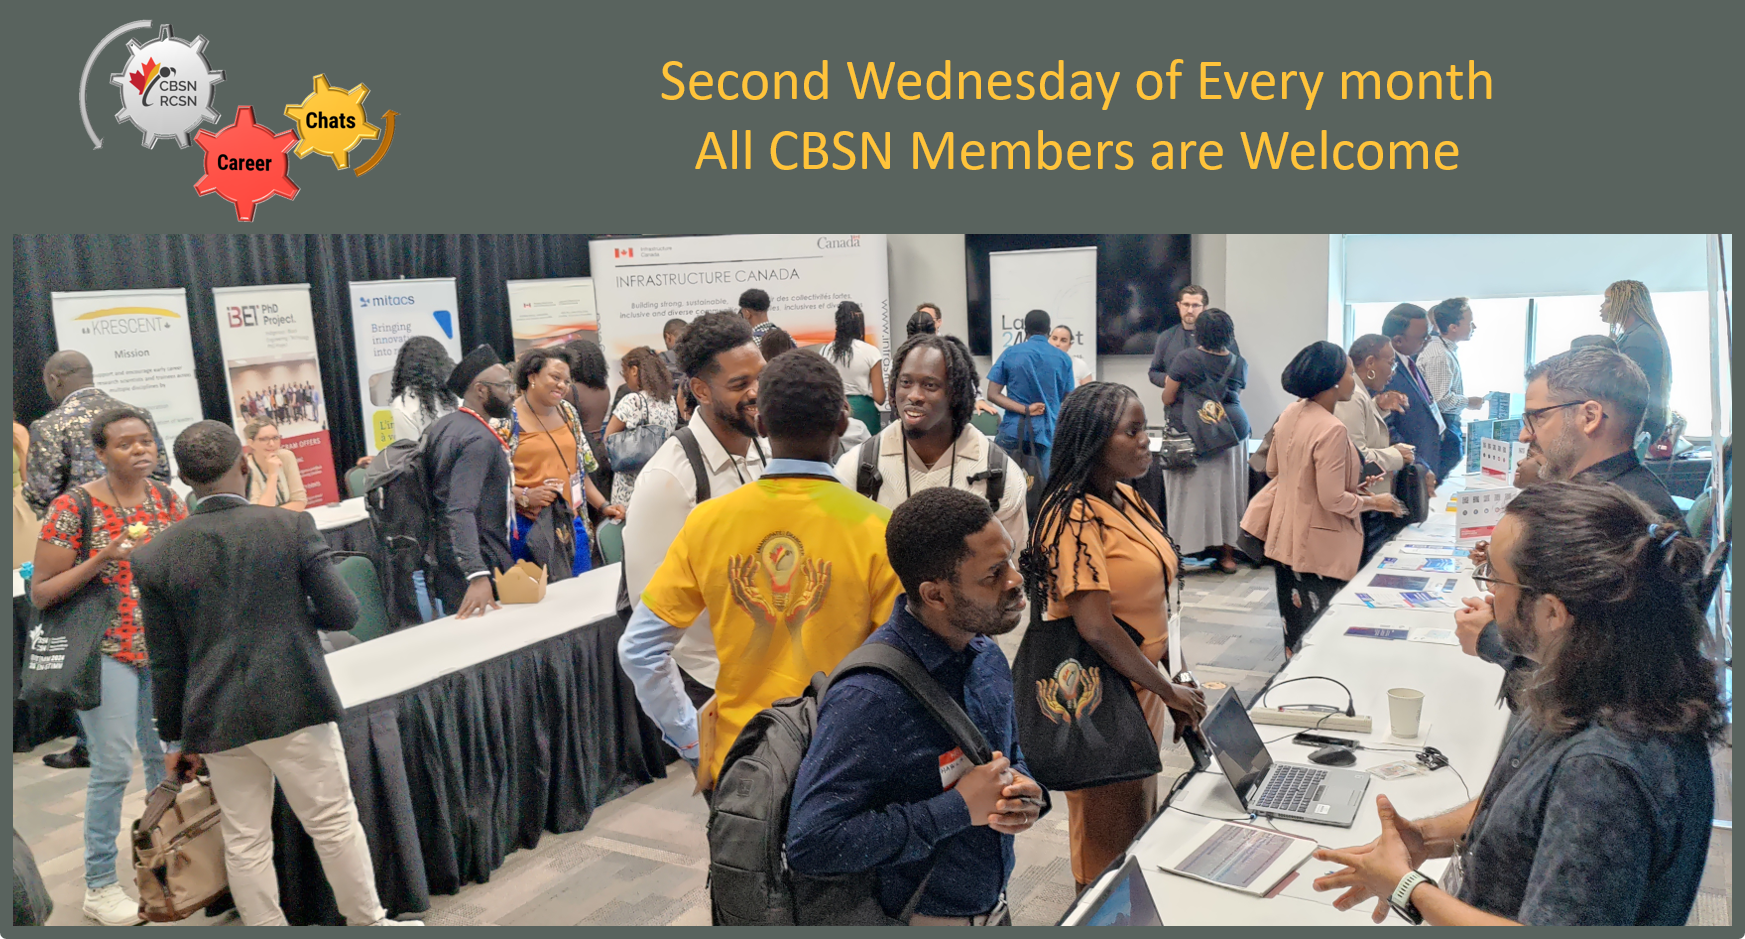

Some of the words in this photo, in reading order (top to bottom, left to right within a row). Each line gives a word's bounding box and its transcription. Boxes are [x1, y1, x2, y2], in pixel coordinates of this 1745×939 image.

[817, 235, 861, 249] Canada
[615, 271, 731, 288] INFRASTRUCTURE
[735, 268, 800, 283] CANADA
[372, 294, 415, 306] mitacs
[261, 304, 279, 314] PhD
[631, 302, 659, 310] Building
[784, 303, 817, 311] inclusives
[619, 311, 650, 319] inclusive
[668, 308, 694, 316] diverse
[92, 317, 162, 336] KRESCENT
[1001, 314, 1026, 330] La
[371, 322, 412, 334] Bringing
[114, 348, 150, 359] Mission
[373, 347, 392, 357] into
[299, 437, 322, 448] OFFERS
